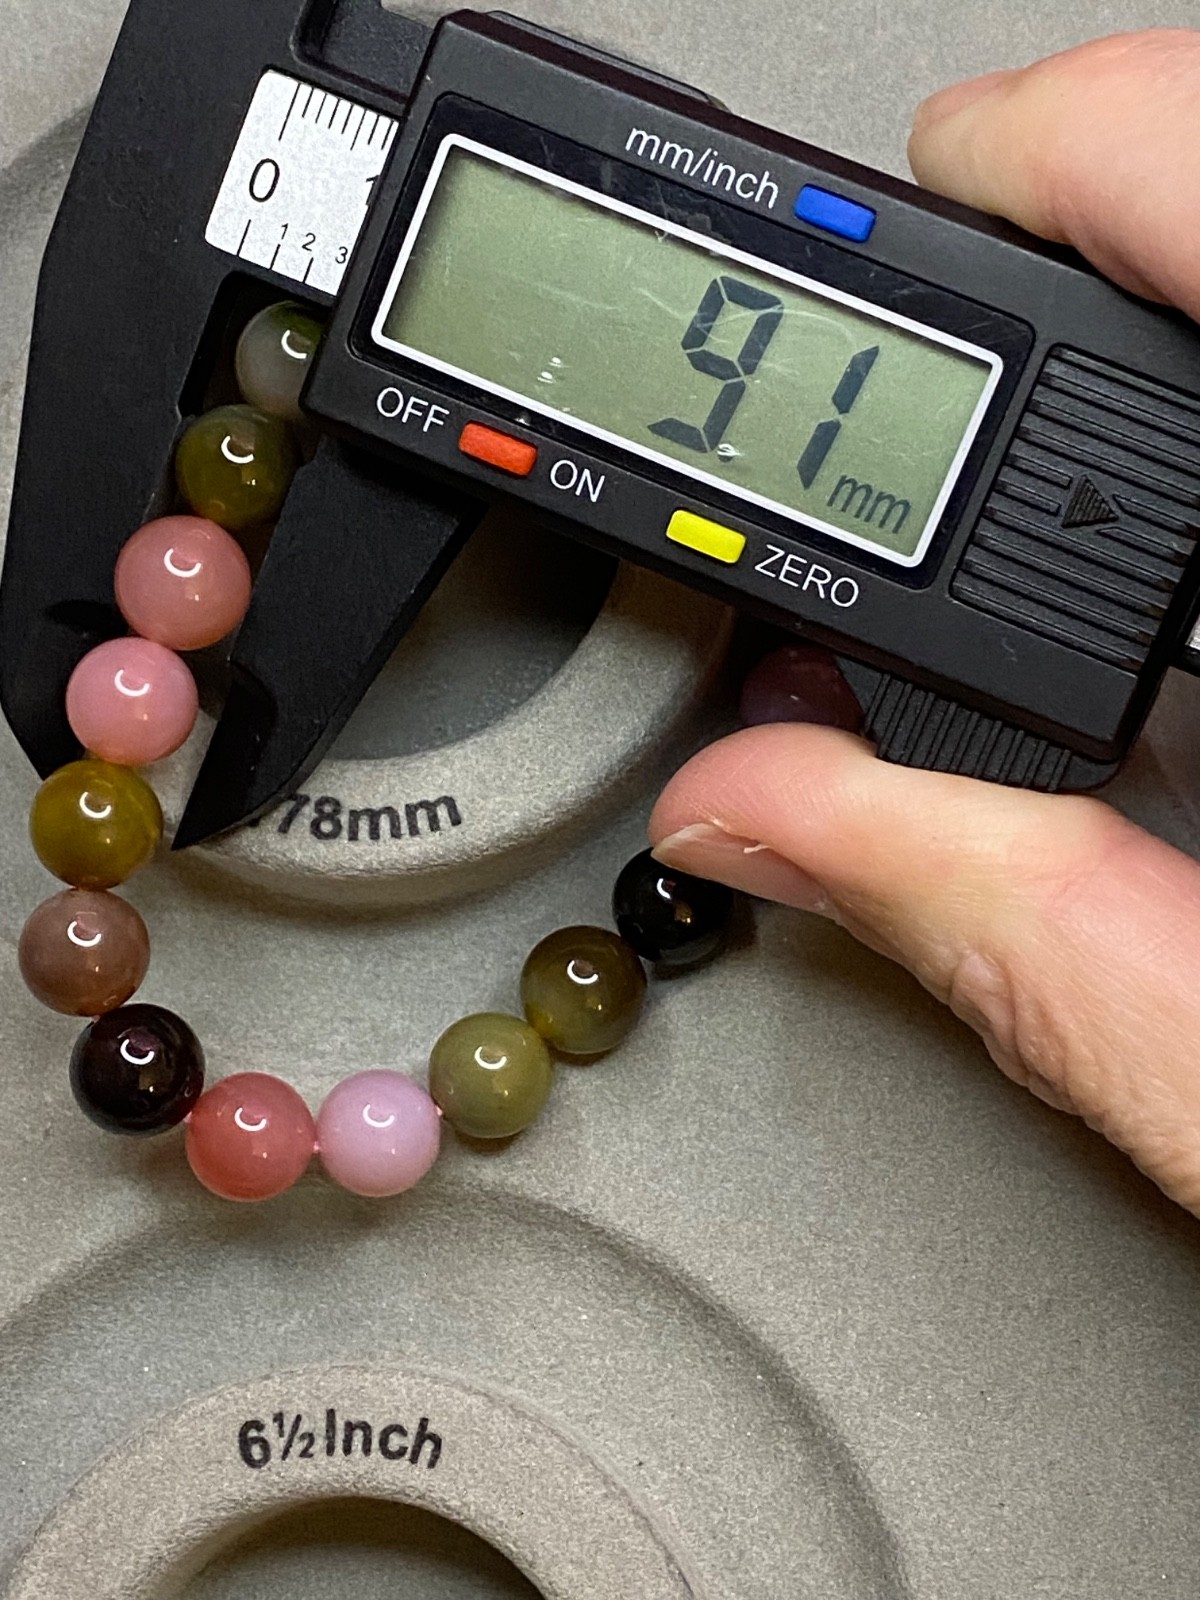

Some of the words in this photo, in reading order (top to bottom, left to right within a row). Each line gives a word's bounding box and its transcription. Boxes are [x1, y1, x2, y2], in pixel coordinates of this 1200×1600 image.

[249, 158, 281, 203] 0
[625, 127, 779, 210] mm/inch
[281, 223, 289, 240] 1
[302, 232, 316, 251] 2
[335, 246, 349, 264] 3
[376, 386, 450, 432] OFF
[549, 459, 606, 503] ON
[827, 474, 912, 535] mm
[754, 544, 860, 608] ZERO
[249, 793, 462, 842] 78mm
